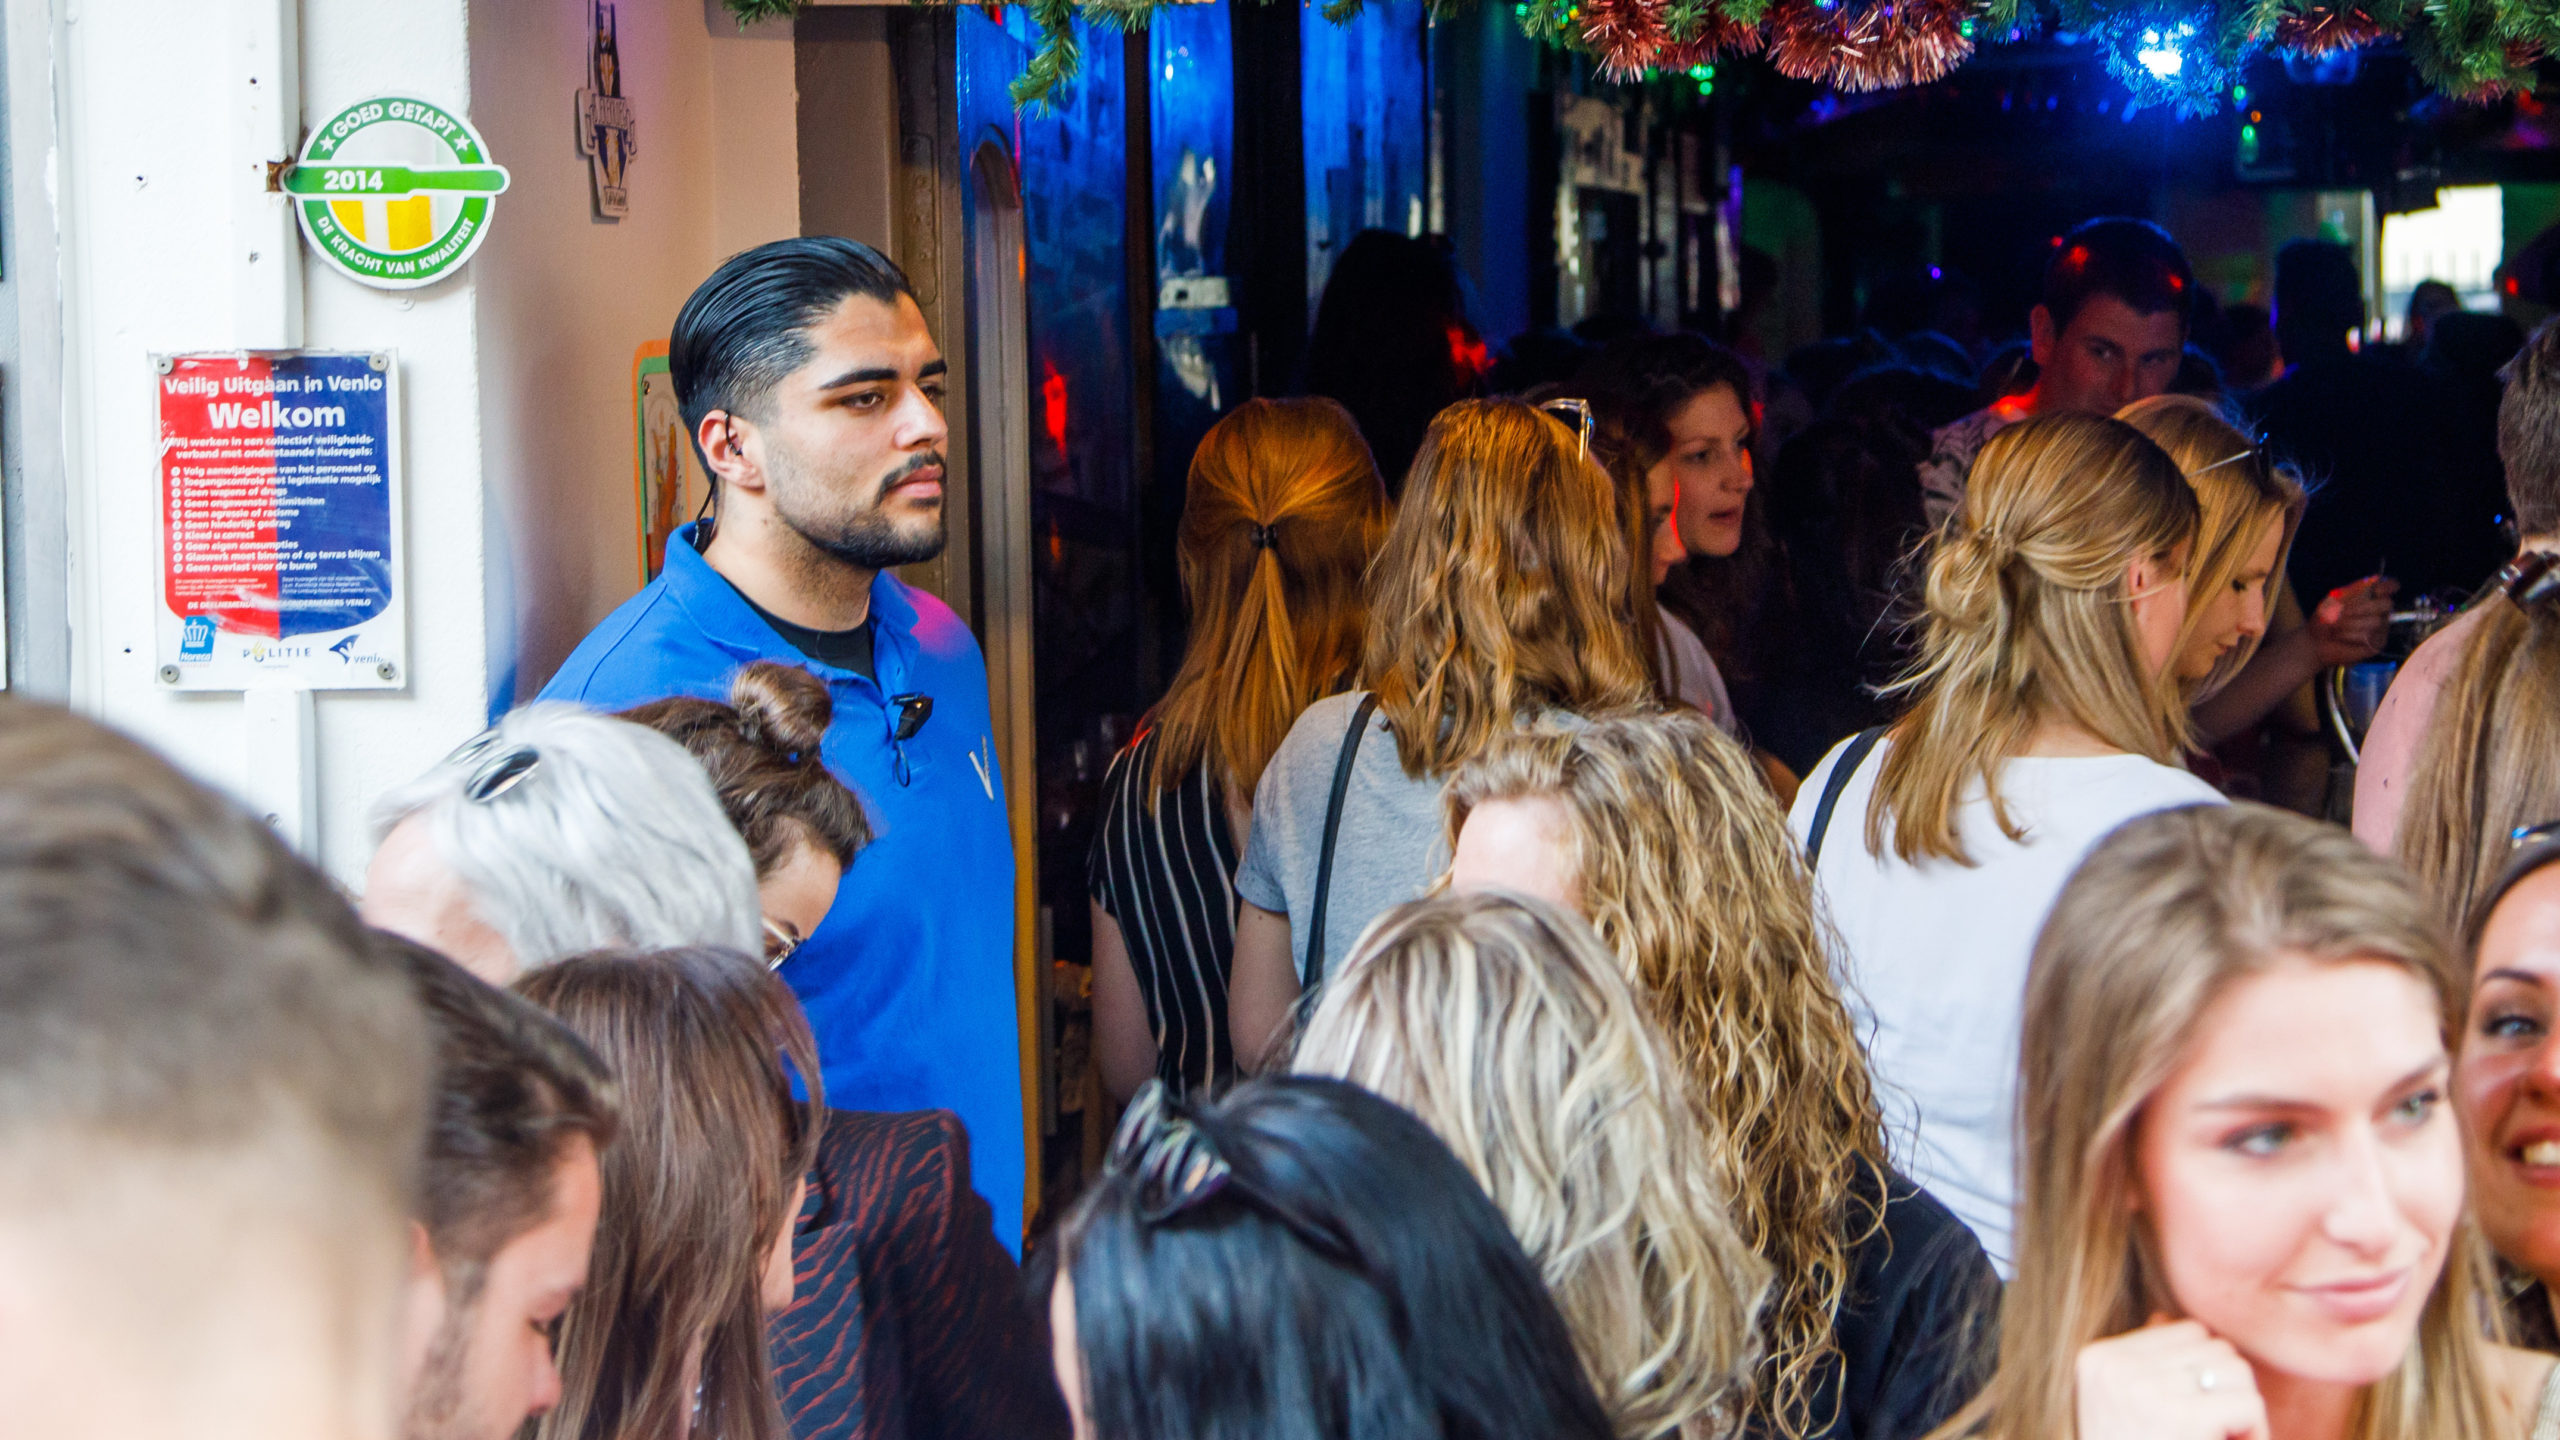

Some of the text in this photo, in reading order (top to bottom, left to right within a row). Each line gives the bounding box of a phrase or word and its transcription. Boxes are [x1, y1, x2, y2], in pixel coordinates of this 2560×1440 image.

[332, 101, 458, 138] GOED GETAPT
[324, 170, 383, 191] 2014
[317, 216, 474, 275] DE KRACHT VAN KWALITEIT
[164, 373, 383, 398] Veilig Uitgaan in Venlo
[207, 400, 346, 430] Welkom
[190, 437, 229, 447] werken
[231, 436, 242, 446] in
[243, 438, 263, 446] een
[265, 434, 313, 446] collectief
[315, 434, 374, 447] veiligheids-
[176, 448, 219, 459] verband
[221, 449, 242, 458] met
[244, 447, 315, 458] onderstaande
[183, 466, 205, 477] Volg
[280, 466, 297, 474] van
[298, 464, 315, 473] het
[316, 463, 362, 474] personeel
[364, 465, 377, 473] op
[184, 474, 382, 488] Toegangscontrole met legitimatie mogelijk
[184, 487, 288, 498] Geen wapens of drugs
[184, 499, 209, 508] Geen
[184, 508, 299, 520] Geen agressie of racisme
[184, 519, 291, 530] Geen hinderlijk gedrag
[185, 531, 212, 540] Kleed
[222, 531, 254, 540] correct
[185, 540, 298, 552] Geen eigen consumpties
[185, 549, 380, 562] Glaswerk moet binnen of op terras blijven
[186, 563, 210, 572] Geen
[212, 563, 250, 571] overlast
[275, 562, 287, 571] de
[289, 561, 317, 571] buren
[181, 652, 212, 661] Horeca
[243, 646, 312, 663] POLITIE
